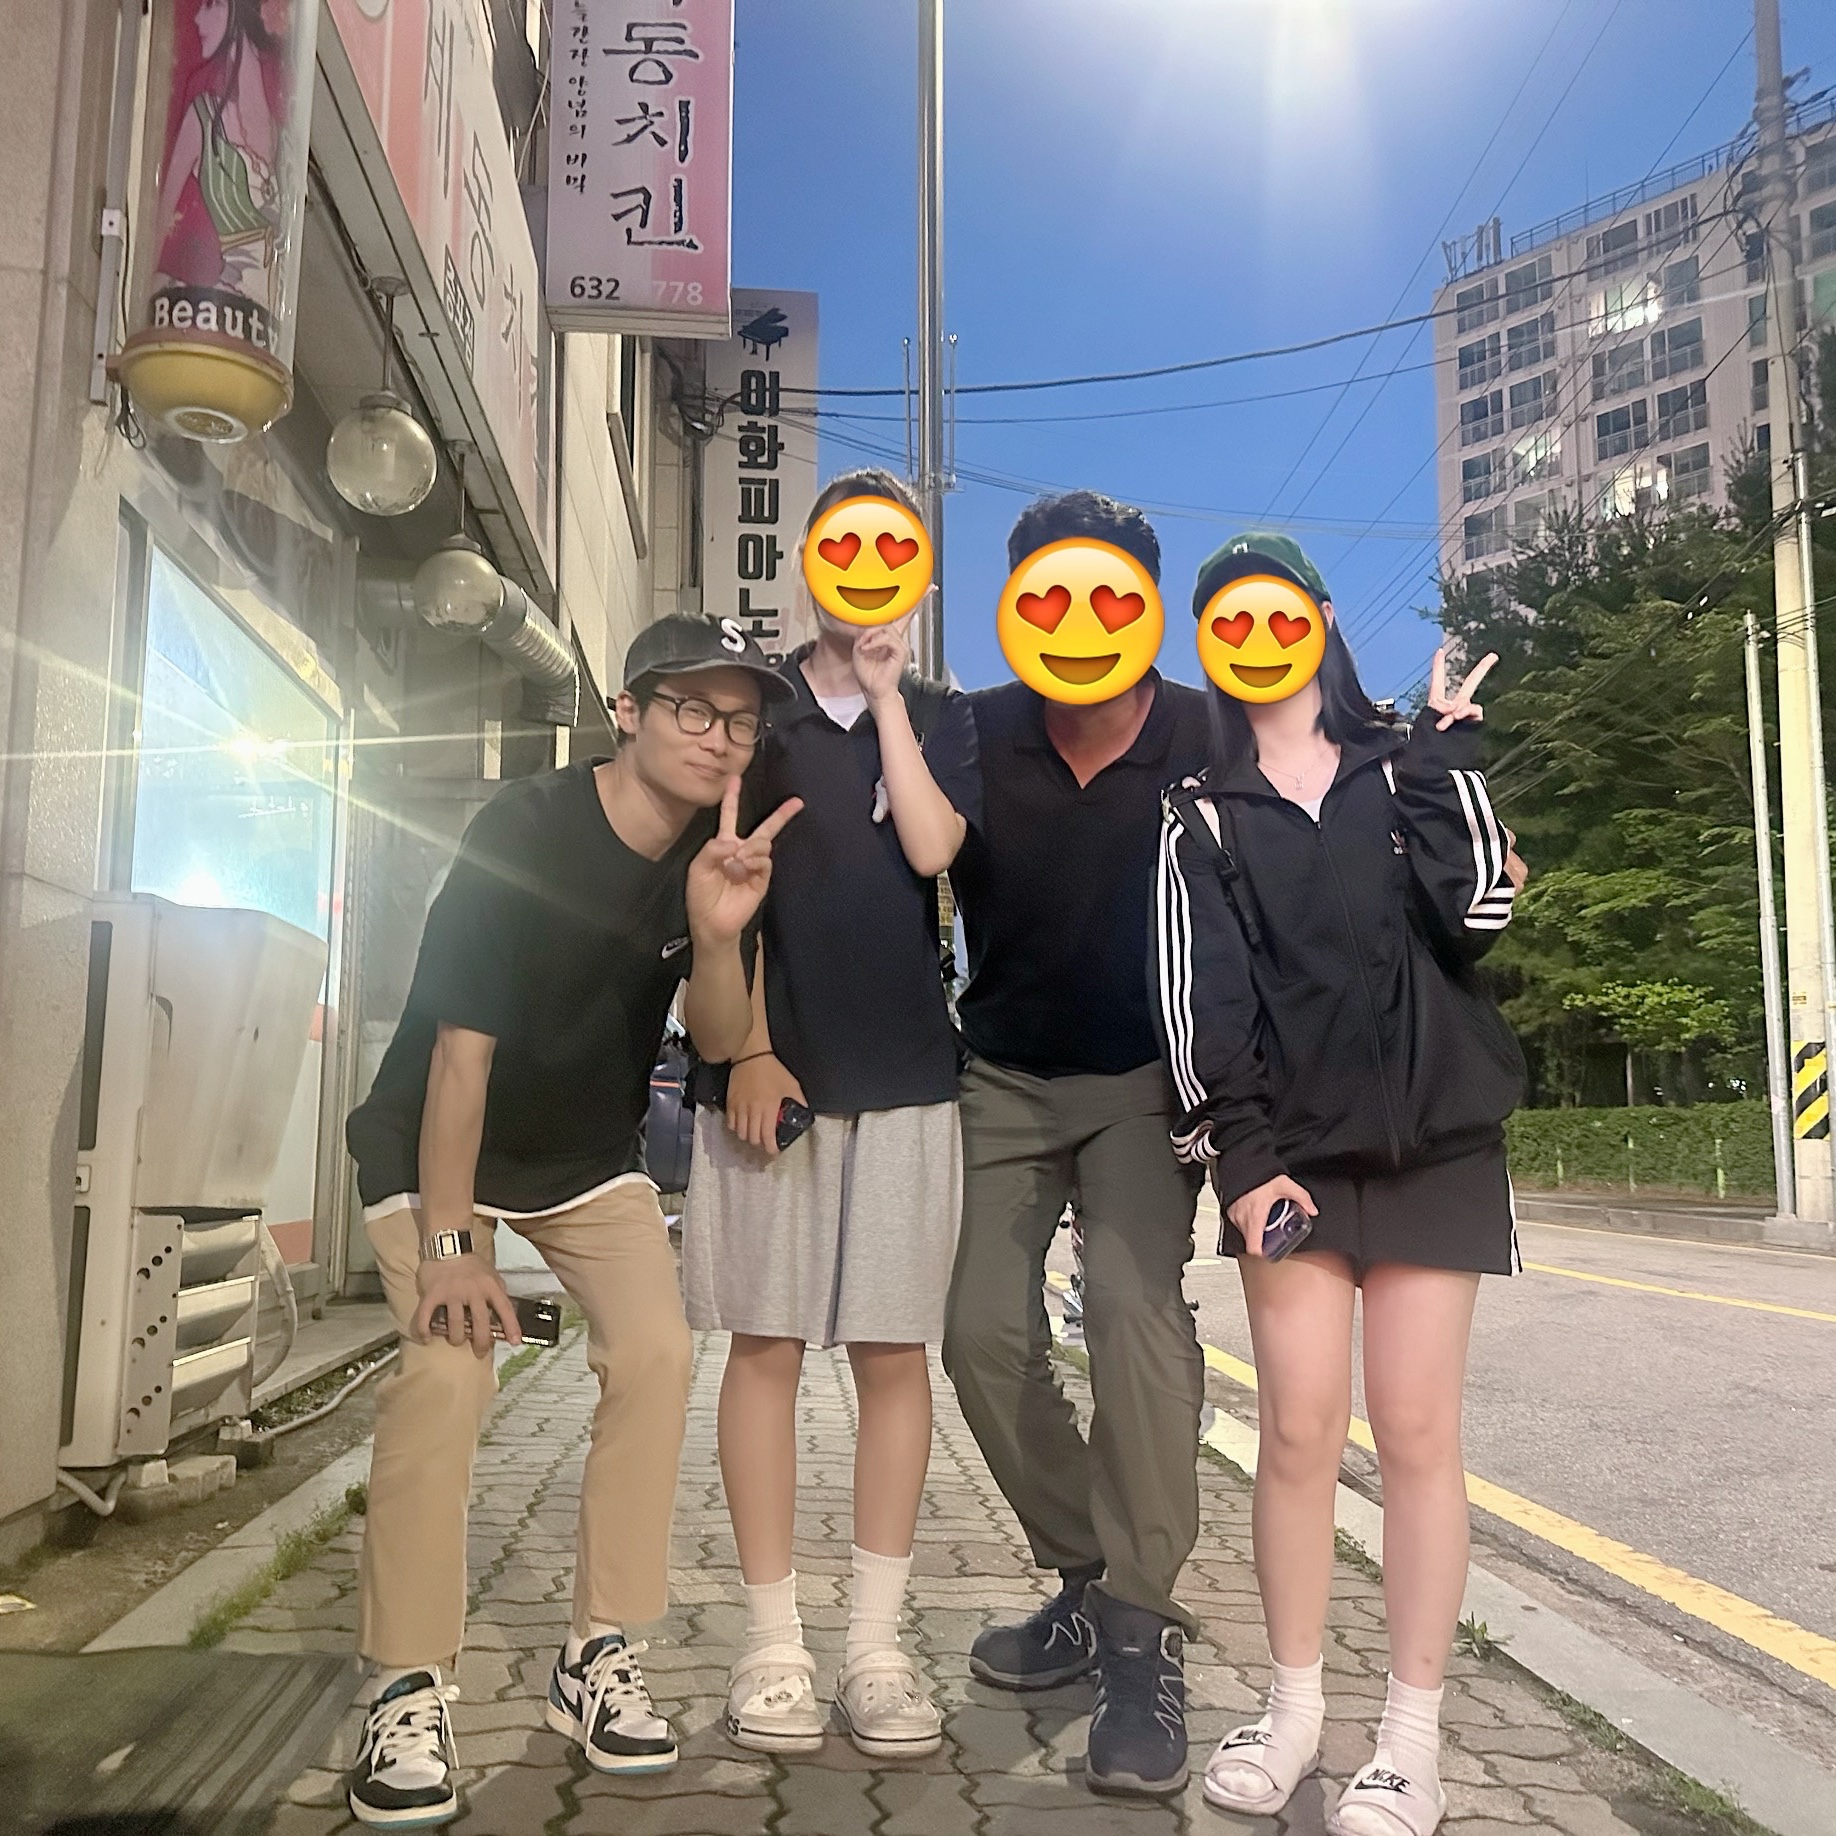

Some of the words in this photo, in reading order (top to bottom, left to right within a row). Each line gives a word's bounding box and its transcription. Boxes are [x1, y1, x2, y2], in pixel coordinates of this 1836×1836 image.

[569, 275, 620, 301] 632
[737, 369, 785, 639] 이화피아노
[721, 618, 746, 654] S
[1366, 1768, 1411, 1790] NIKE
